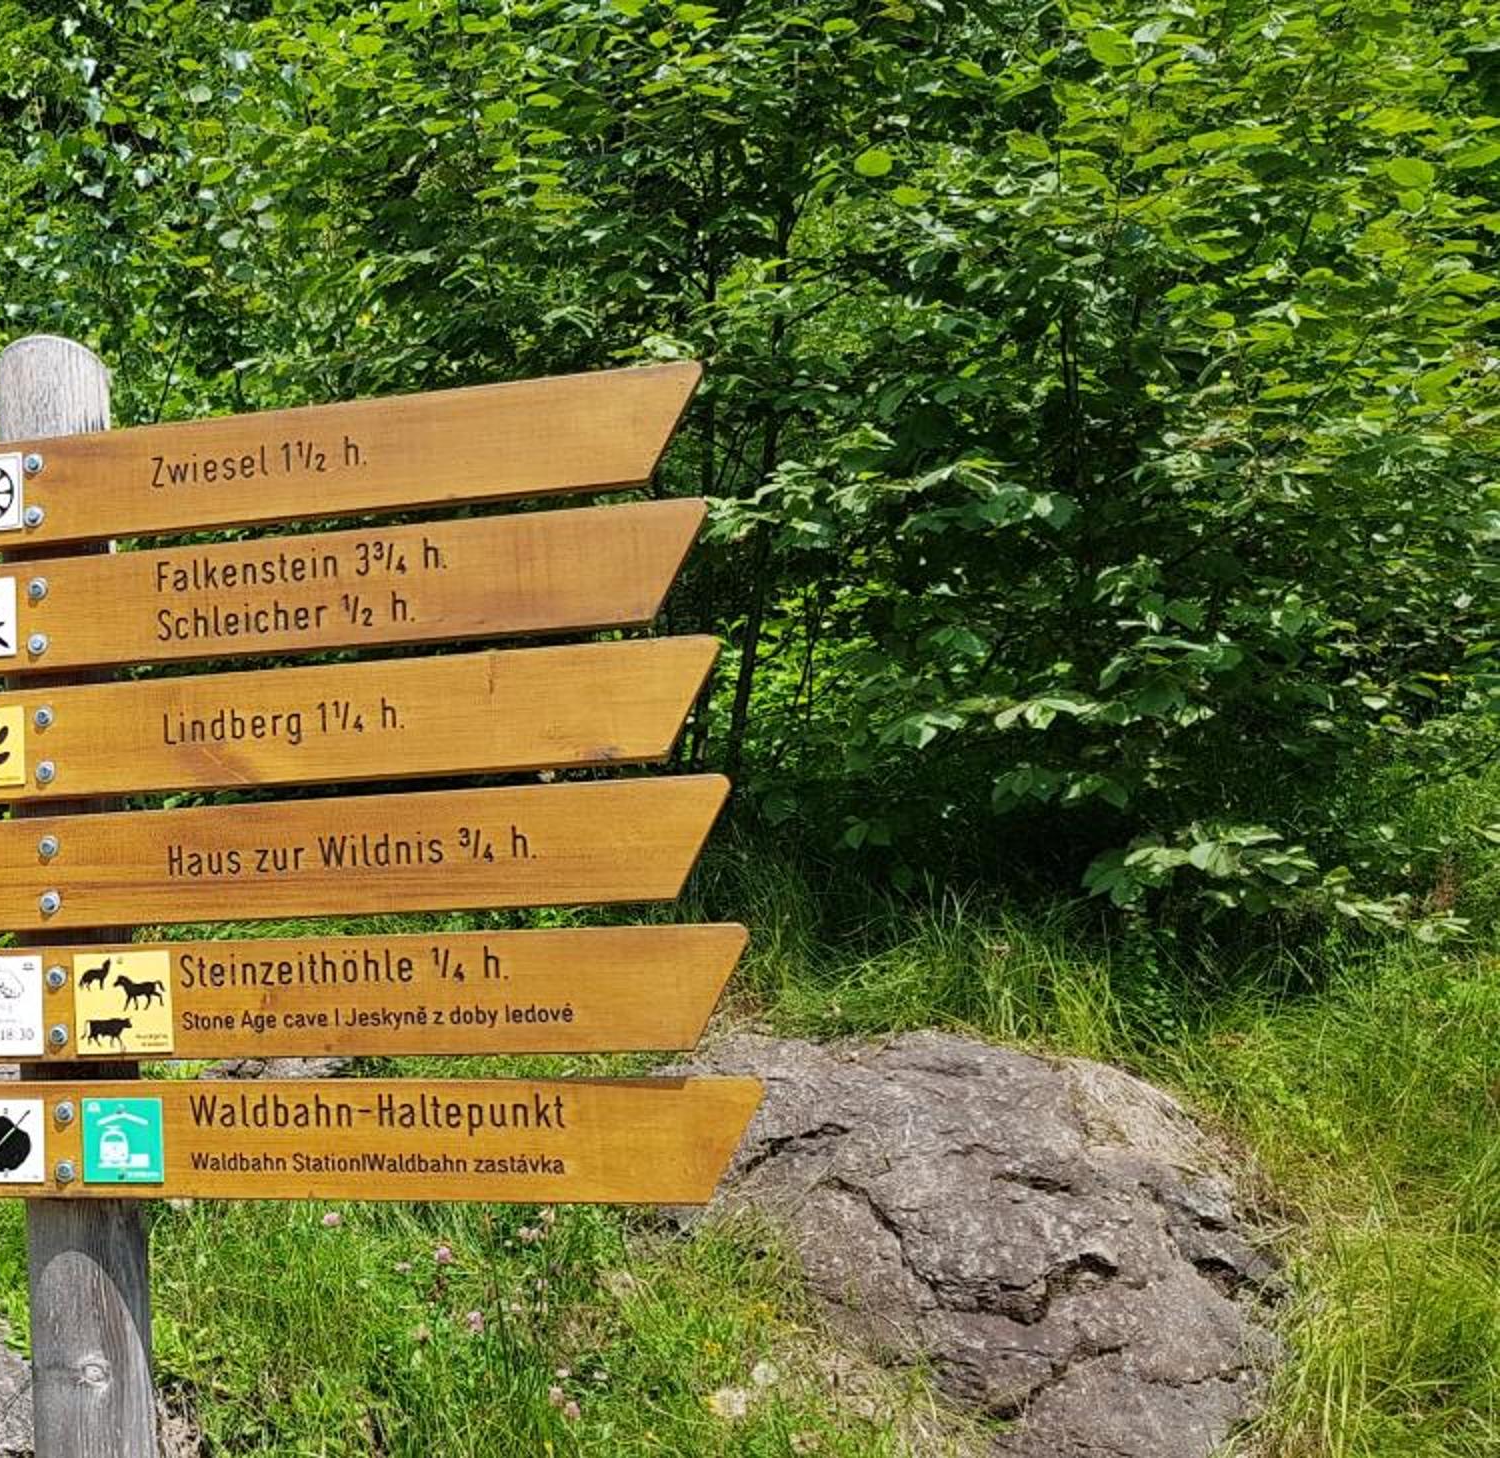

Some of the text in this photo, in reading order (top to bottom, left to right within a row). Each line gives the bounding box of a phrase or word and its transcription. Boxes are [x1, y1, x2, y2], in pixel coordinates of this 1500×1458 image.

[151, 444, 267, 490] Zwiesel
[343, 436, 367, 467] h.
[156, 553, 338, 595] Falkenstein
[422, 537, 448, 570] h.
[157, 599, 329, 642] Schleicher
[390, 591, 416, 623] h.
[163, 703, 303, 746] Lindberg
[382, 696, 405, 727] h.
[167, 843, 242, 878] Haus
[255, 845, 306, 873] zur
[318, 833, 445, 870] Wildnis
[511, 824, 538, 861] h.
[179, 951, 415, 988] Steinzeithöhle
[483, 946, 510, 980] h.
[181, 1010, 235, 1031] Stone
[241, 1010, 277, 1033] Age
[283, 1011, 328, 1028] cave
[345, 1007, 427, 1030] Jeskyně
[433, 1010, 444, 1025] z
[449, 1005, 499, 1028] doby
[505, 1001, 574, 1024] ledové
[189, 1092, 566, 1136] Waldbahn-Haltepunkt
[190, 1152, 288, 1173] Waldbahn
[473, 1153, 565, 1175] zastávka
